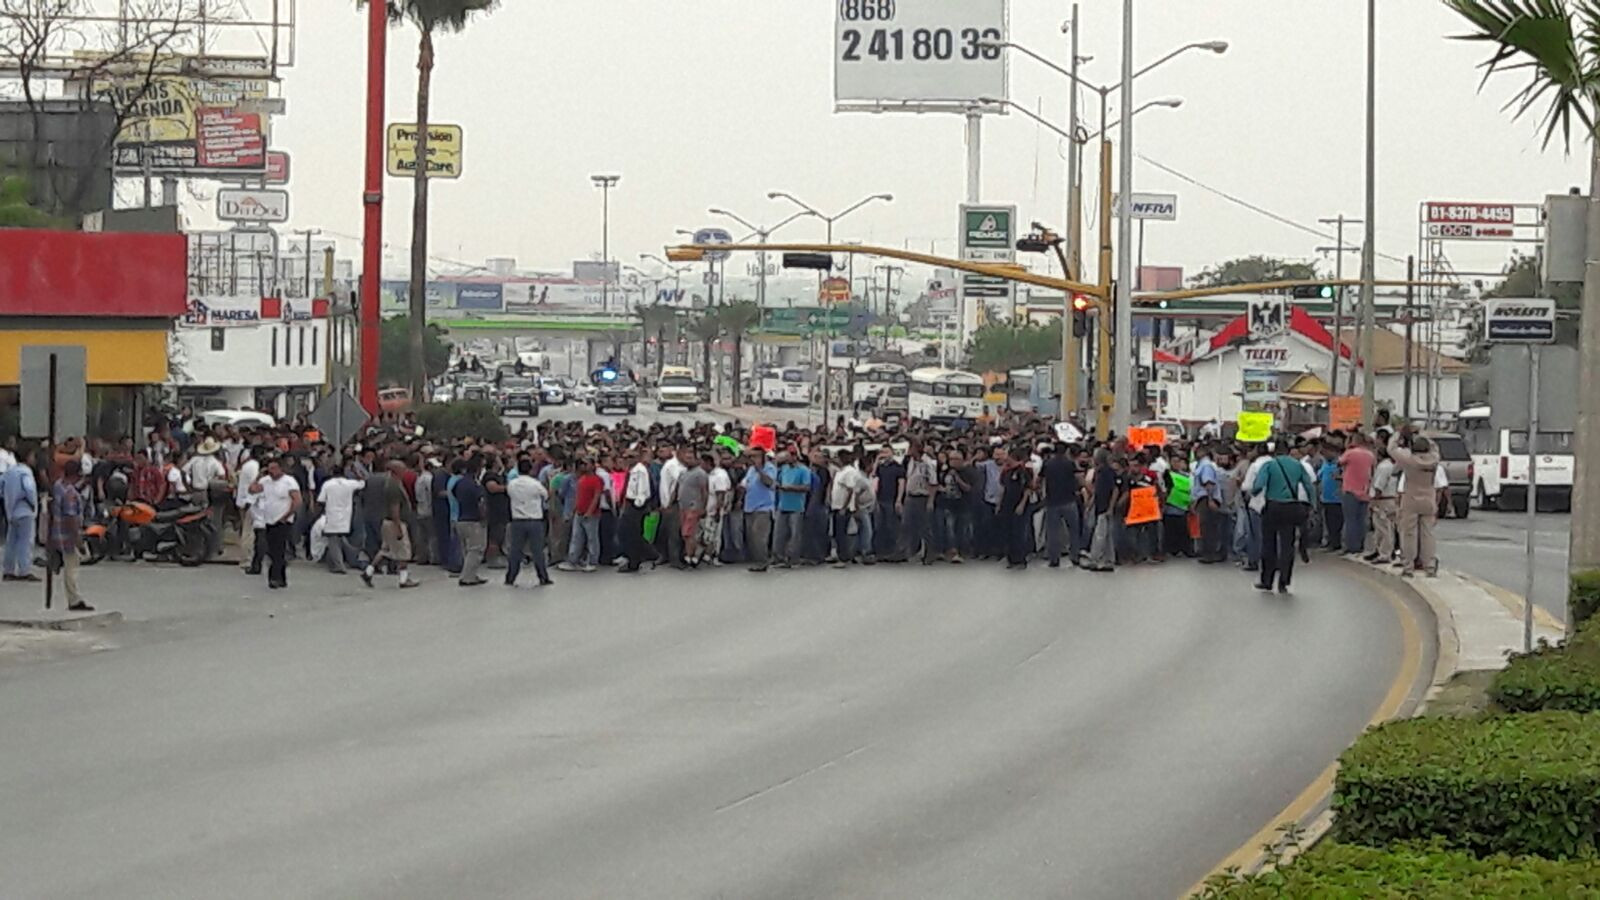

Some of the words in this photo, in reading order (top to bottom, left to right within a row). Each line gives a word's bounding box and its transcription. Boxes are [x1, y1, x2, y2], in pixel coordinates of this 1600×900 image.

[840, 0, 896, 21] (868)
[1130, 203, 1173, 213] NFRA
[211, 310, 259, 320] MARESA
[1245, 348, 1288, 361] TECATE
